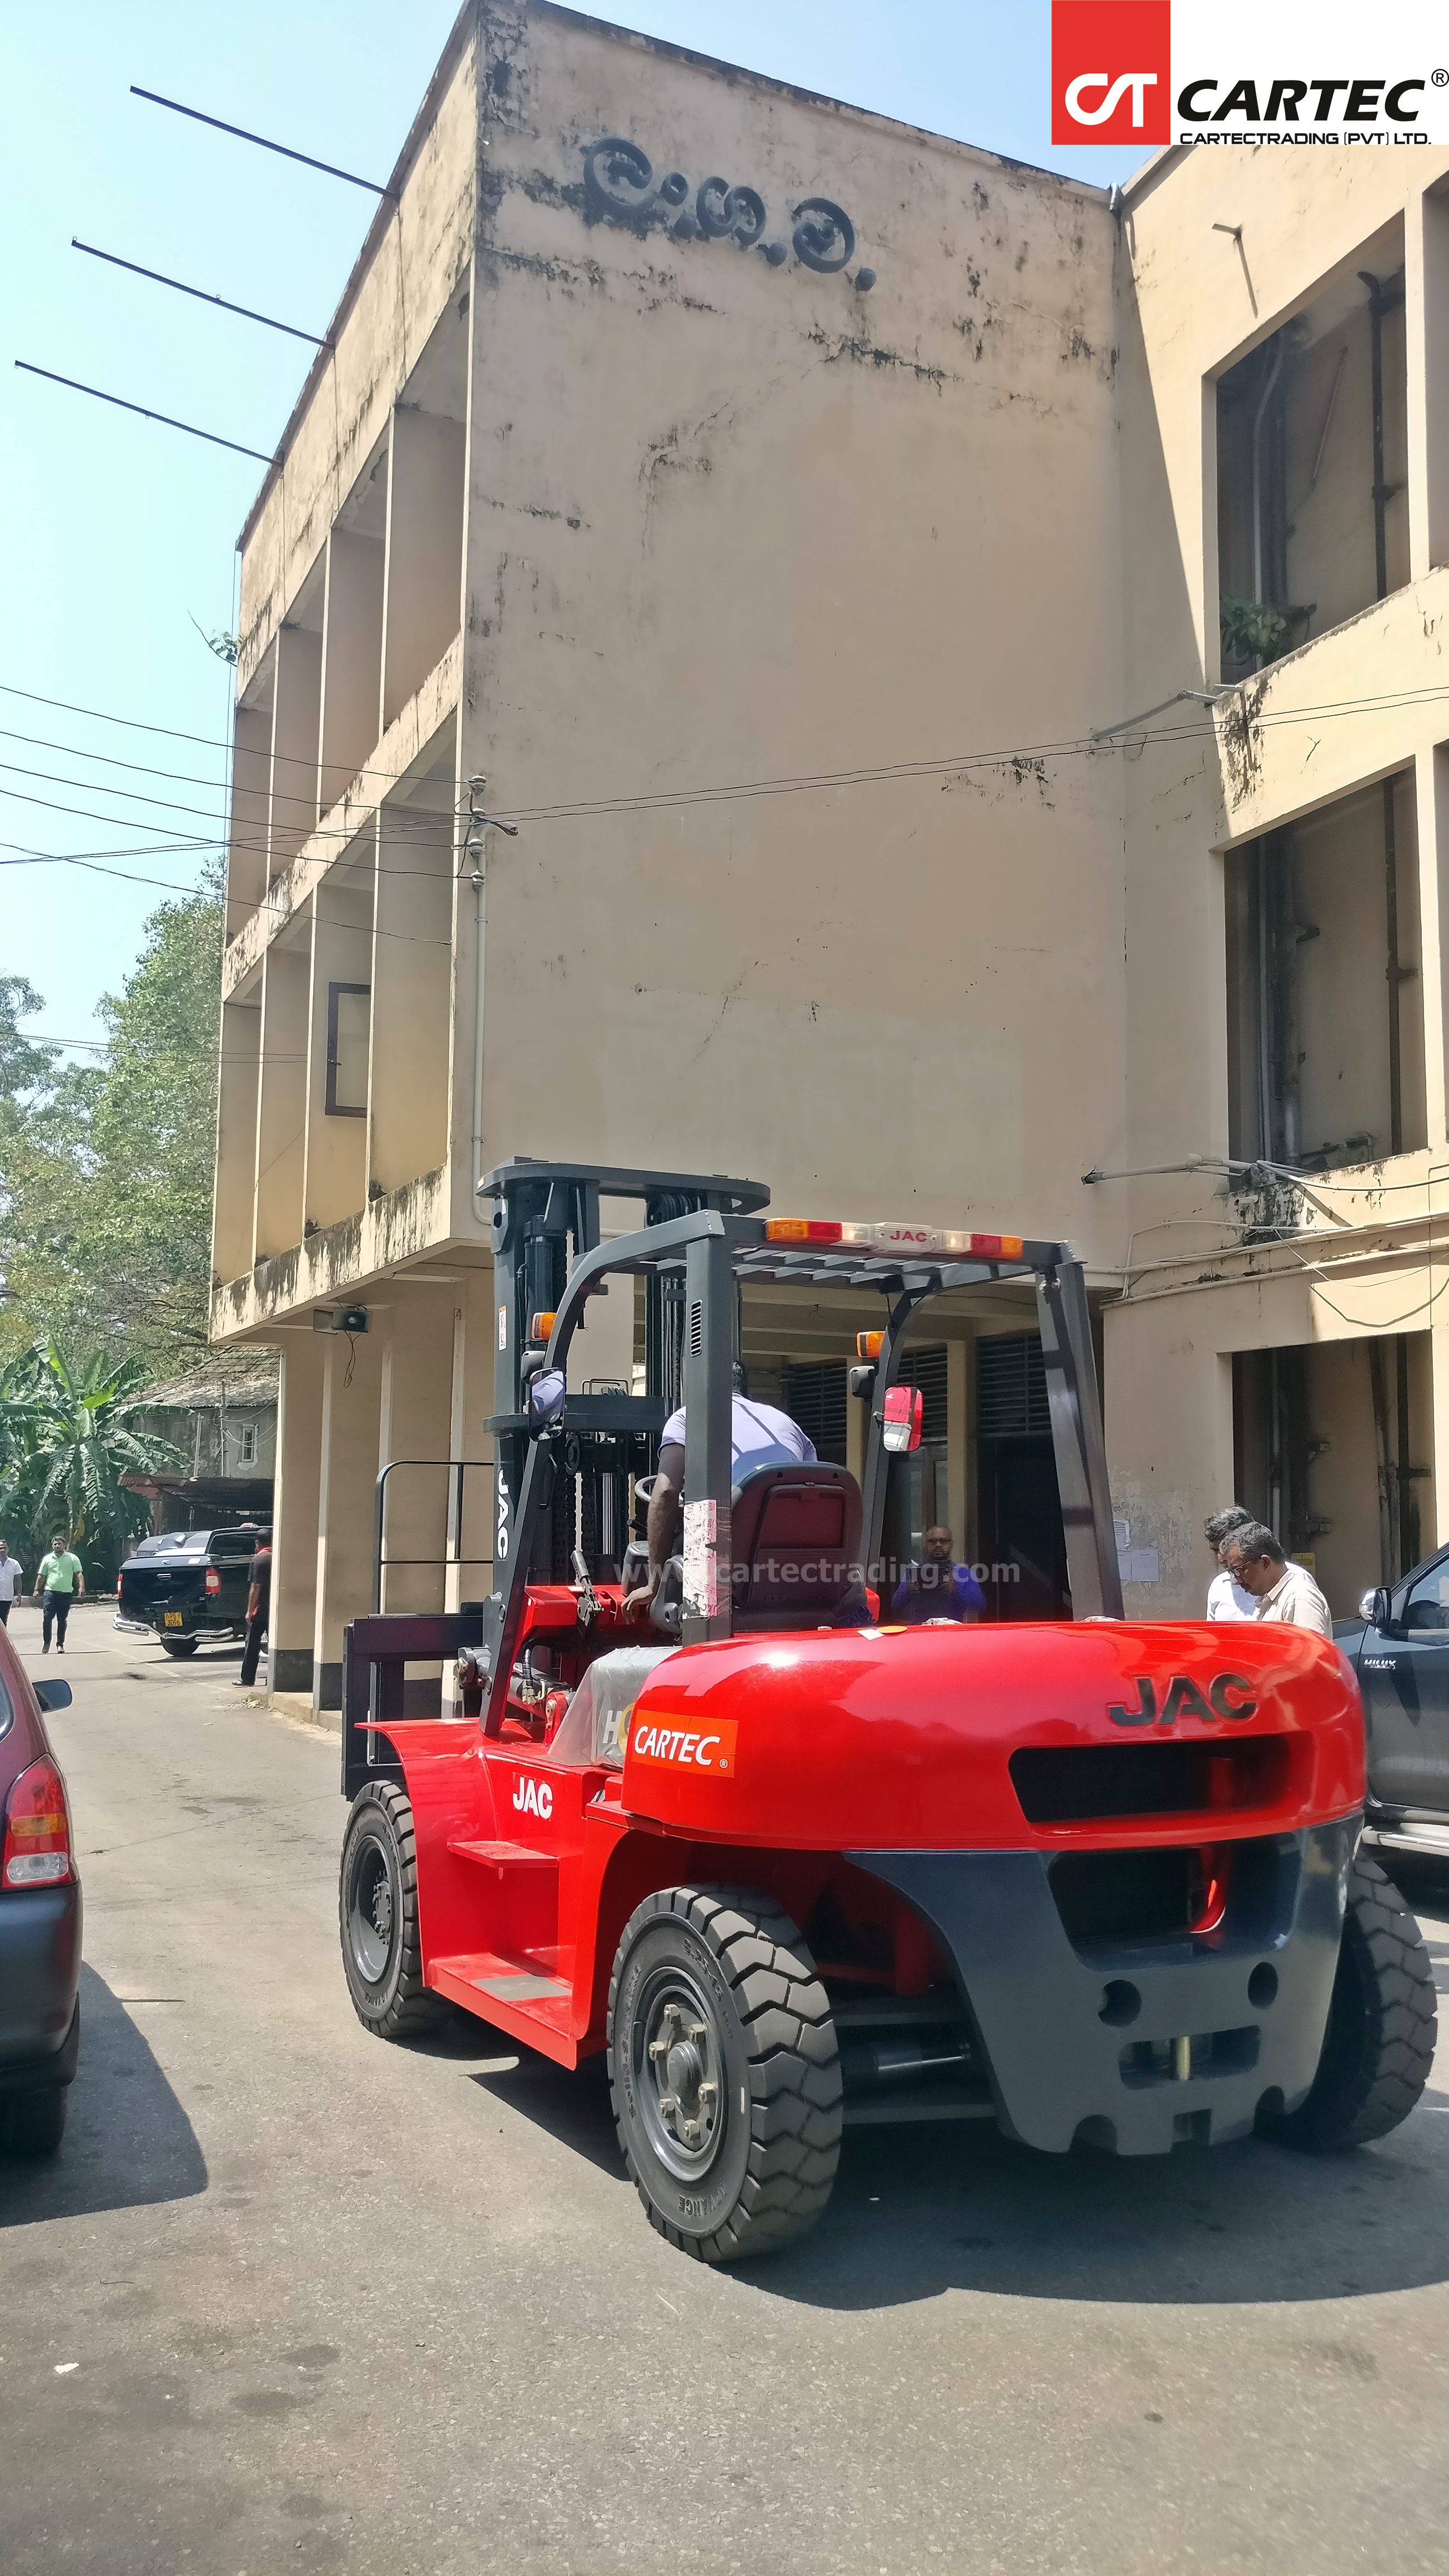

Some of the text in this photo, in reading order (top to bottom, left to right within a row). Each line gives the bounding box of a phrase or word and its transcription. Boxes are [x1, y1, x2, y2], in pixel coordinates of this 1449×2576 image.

[889, 1230, 928, 1243] JAC
[498, 1469, 509, 1559] JAC
[1364, 1659, 1397, 1670] HILUX
[1106, 1672, 1258, 1727] JAC
[635, 1725, 721, 1766] CARTEC
[513, 1776, 553, 1819] JAC
